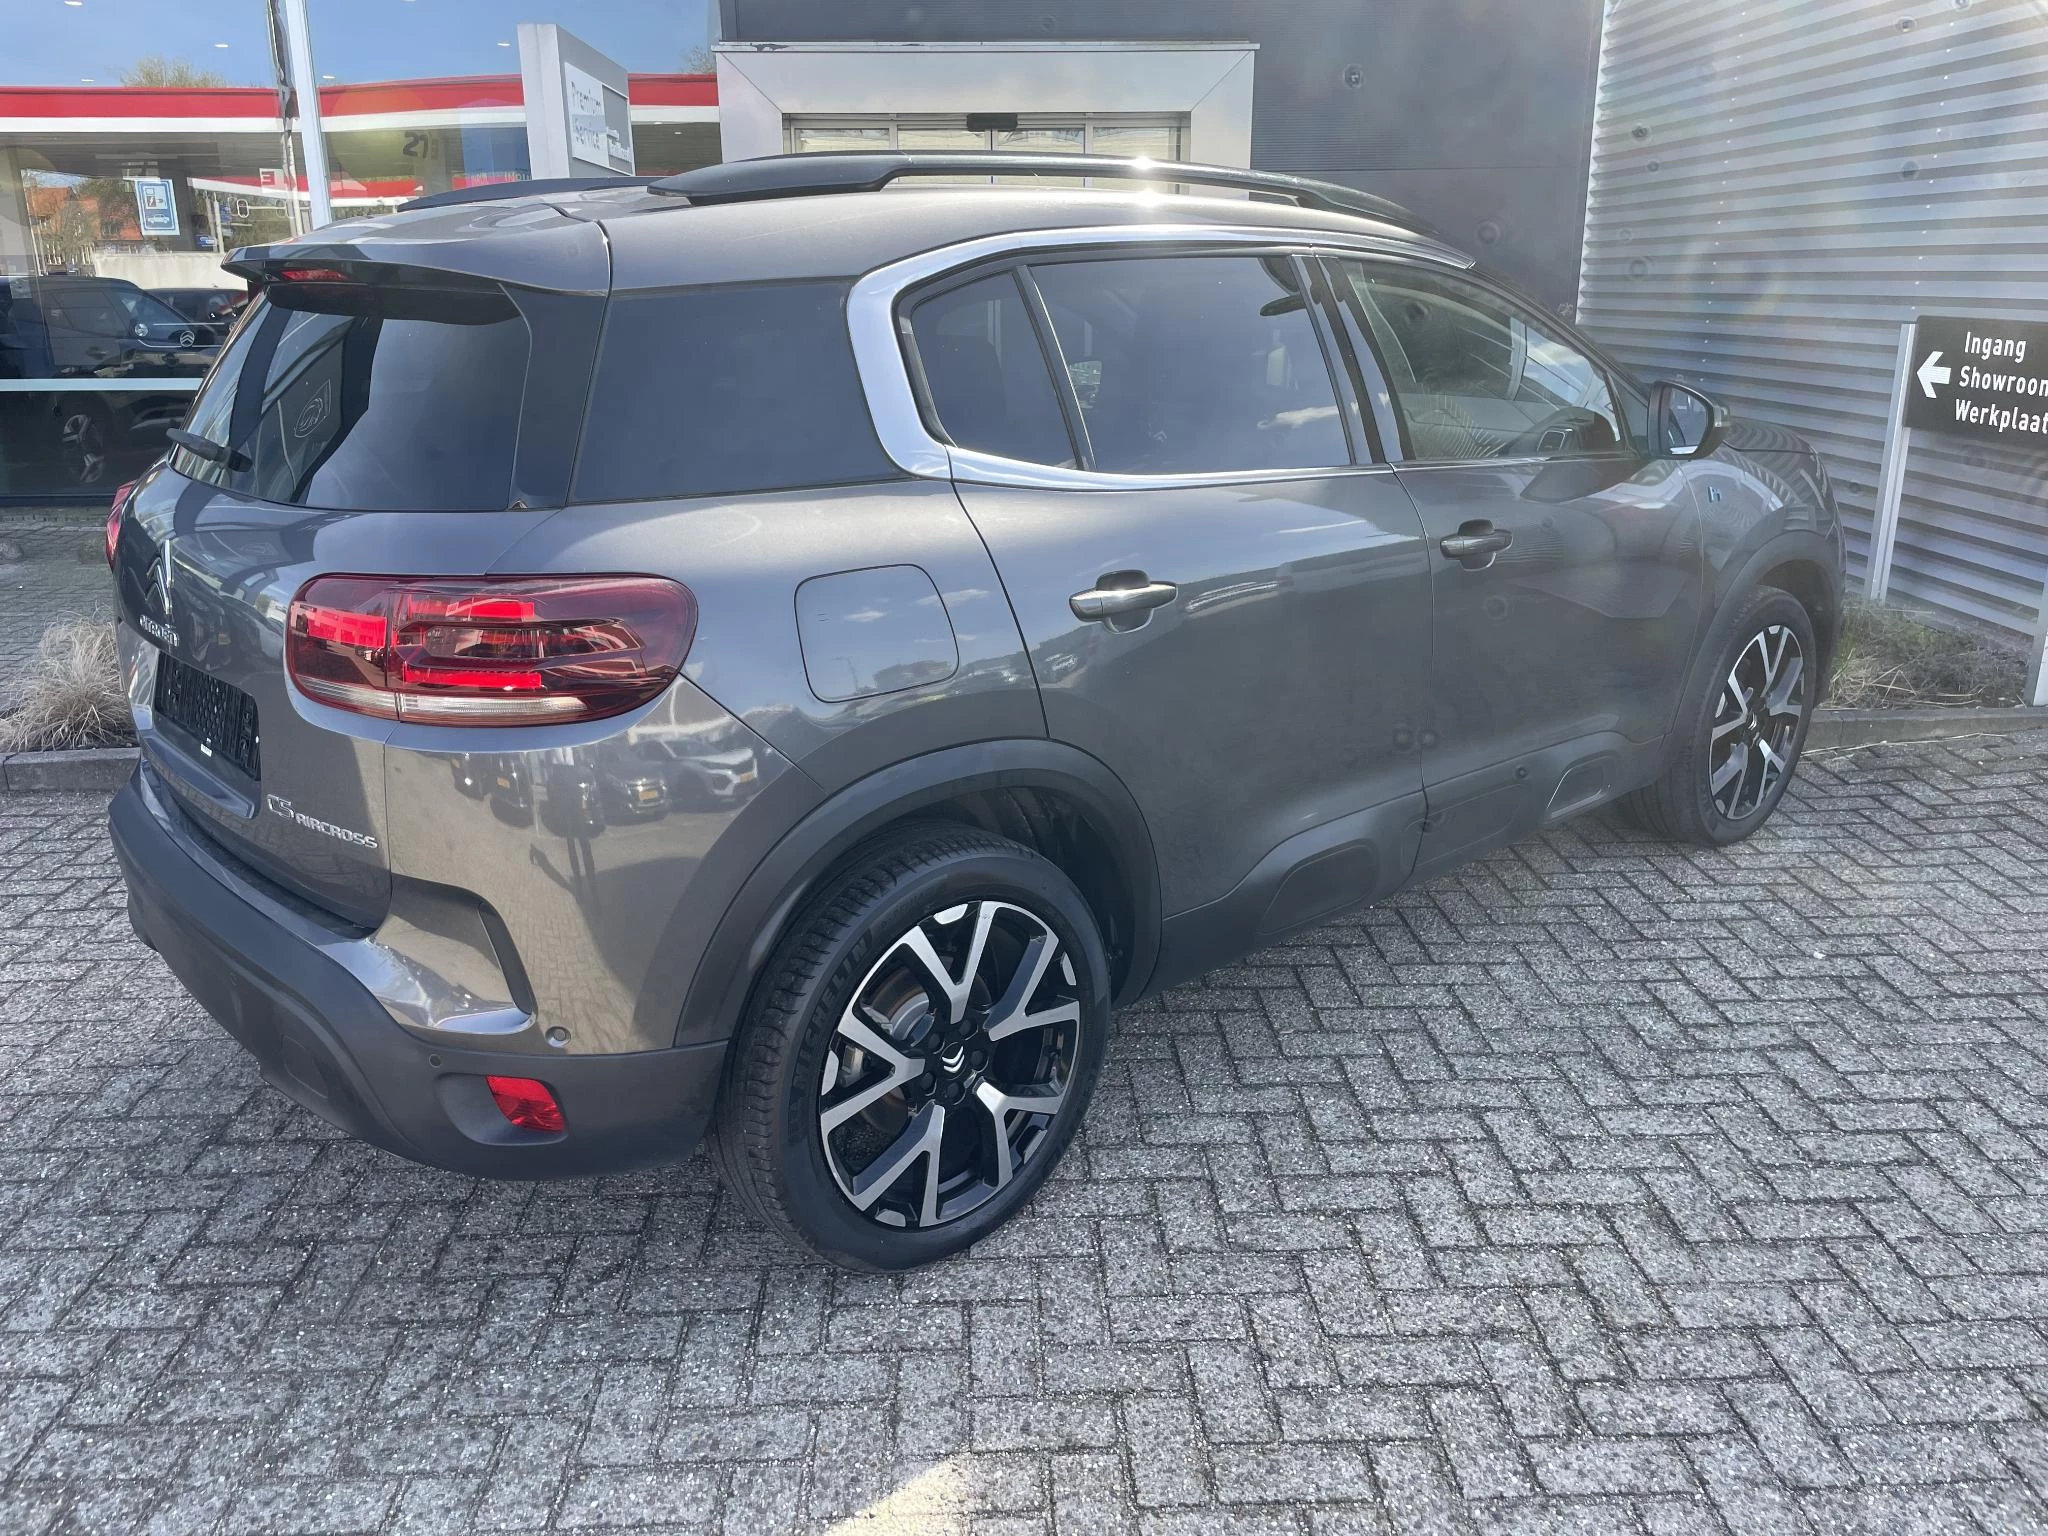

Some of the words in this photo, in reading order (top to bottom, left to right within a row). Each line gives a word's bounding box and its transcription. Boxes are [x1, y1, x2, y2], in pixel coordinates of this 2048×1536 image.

[570, 81, 602, 116] Premium
[1965, 332, 2026, 363] Ingang
[266, 793, 295, 819] C5
[295, 813, 378, 848] AIRCROSS
[792, 934, 868, 1088] MICHELIN
